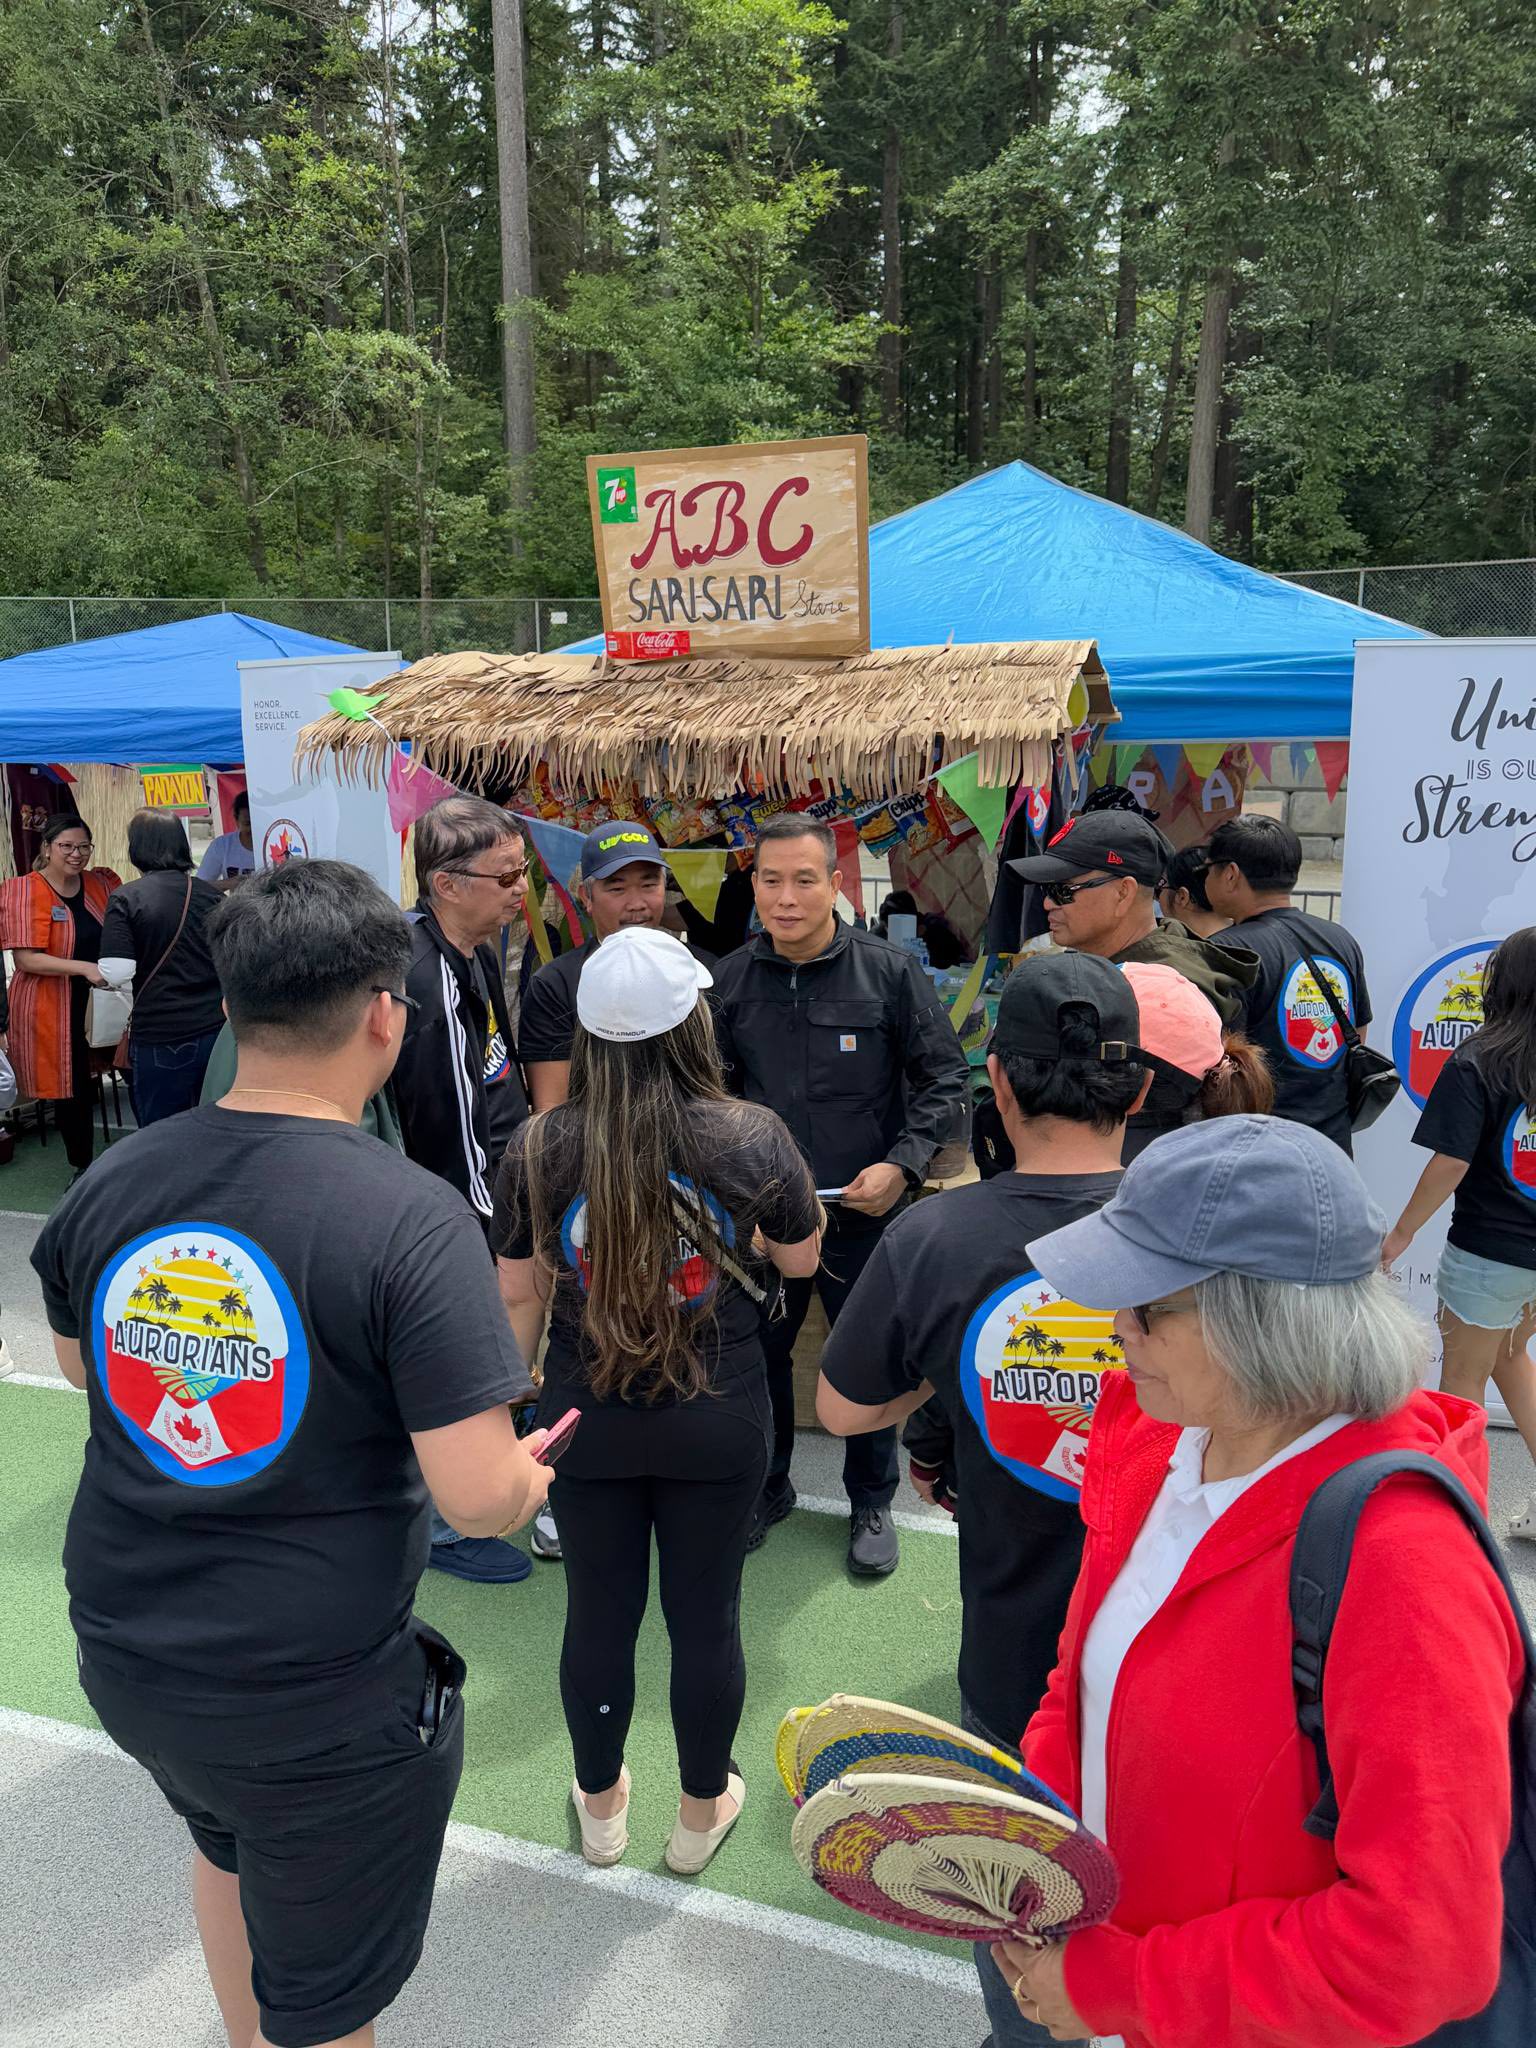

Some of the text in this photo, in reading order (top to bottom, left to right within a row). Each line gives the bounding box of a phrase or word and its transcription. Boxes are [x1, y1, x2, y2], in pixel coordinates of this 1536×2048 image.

[630, 476, 814, 569] ABC
[628, 574, 849, 623] SARI-SARI Store
[254, 700, 282, 709] HONOR.
[254, 711, 301, 720] EXCELLENCE.
[255, 722, 287, 731] SERVICE.
[1467, 759, 1491, 780] IS
[1422, 1022, 1482, 1048] AUR
[113, 1319, 272, 1380] AURORIANS
[993, 1369, 1101, 1404] AUROR
